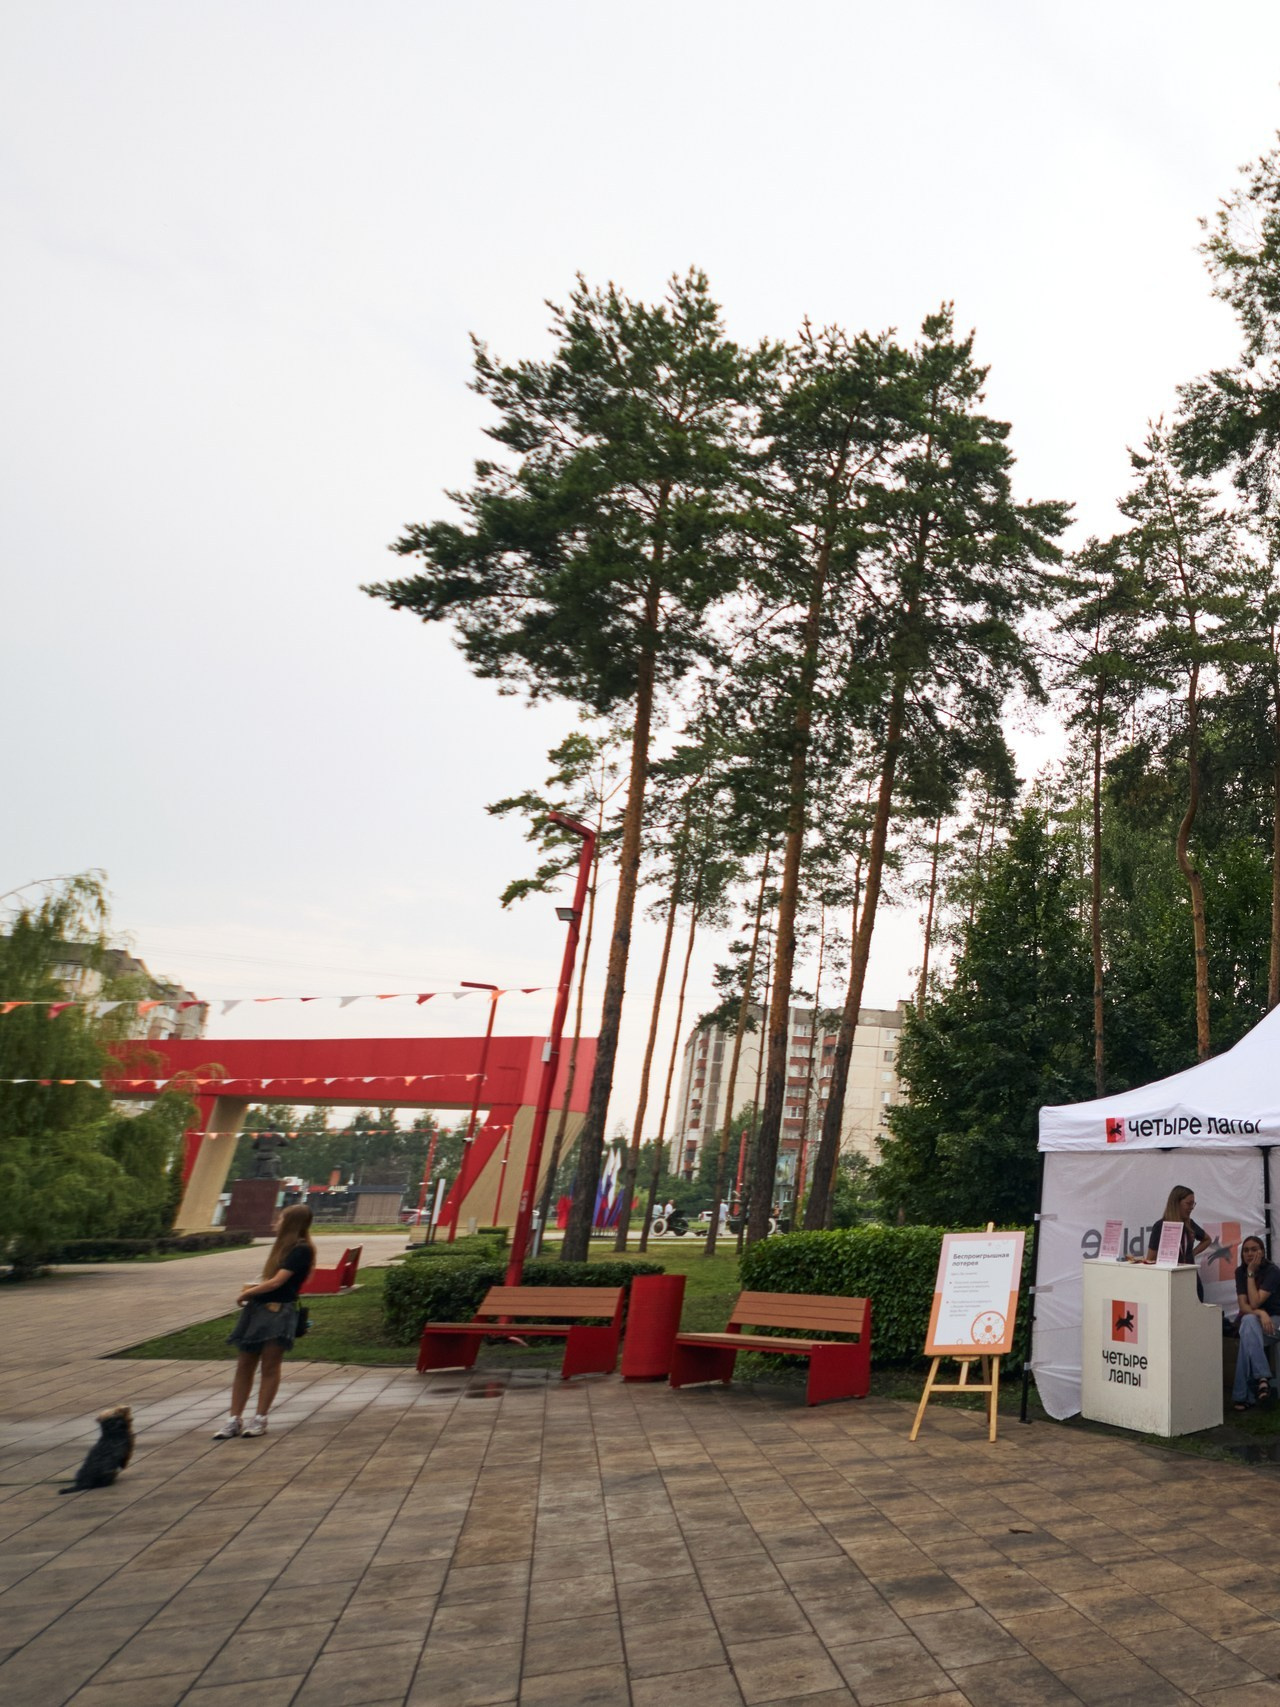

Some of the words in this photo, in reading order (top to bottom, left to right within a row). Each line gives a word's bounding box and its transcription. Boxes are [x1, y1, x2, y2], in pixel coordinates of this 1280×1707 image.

[1128, 1117, 1202, 1137] четыре
[1207, 1117, 1262, 1135] лапы
[1102, 1350, 1148, 1370] четыре
[1109, 1368, 1141, 1387] лапы
